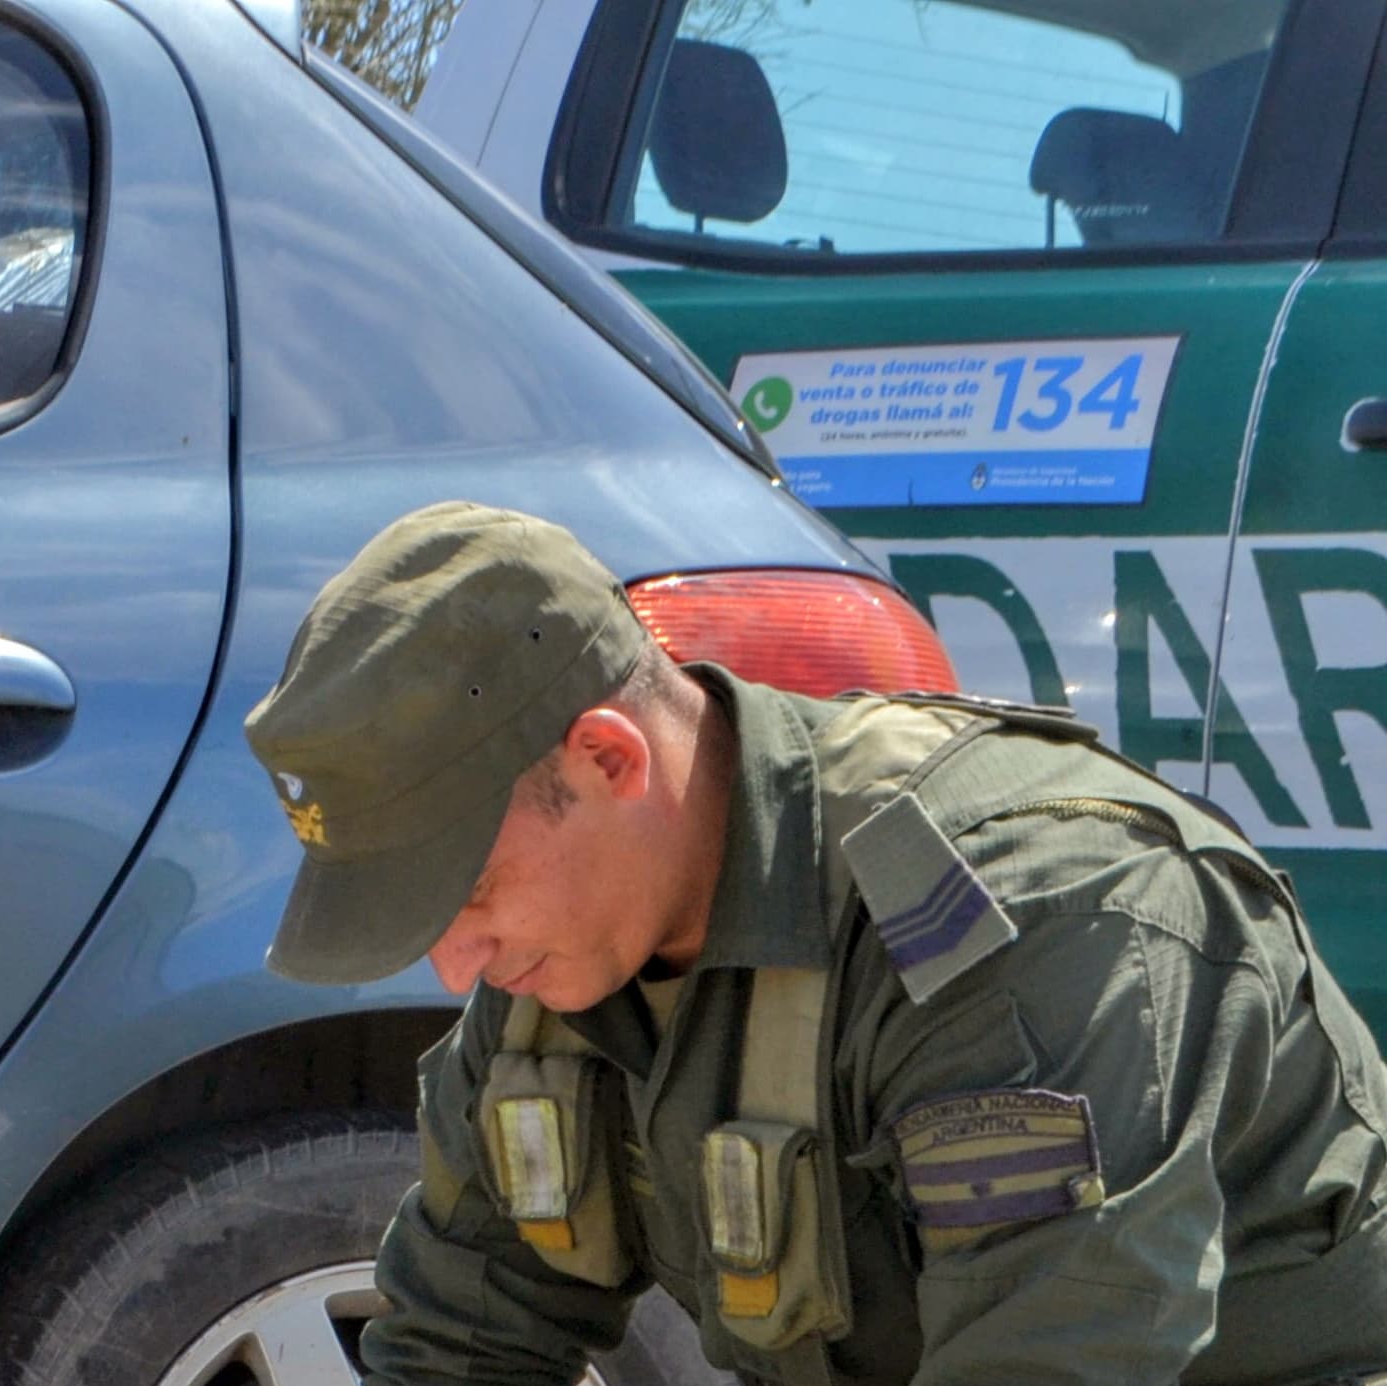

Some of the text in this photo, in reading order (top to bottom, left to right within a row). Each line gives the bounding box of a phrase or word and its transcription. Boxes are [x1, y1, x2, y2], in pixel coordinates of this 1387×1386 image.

[830, 357, 987, 377] Para denunciar
[799, 379, 979, 402] venta o tráfico de
[992, 353, 1144, 433] 134
[810, 401, 973, 427] drogas llamá al:
